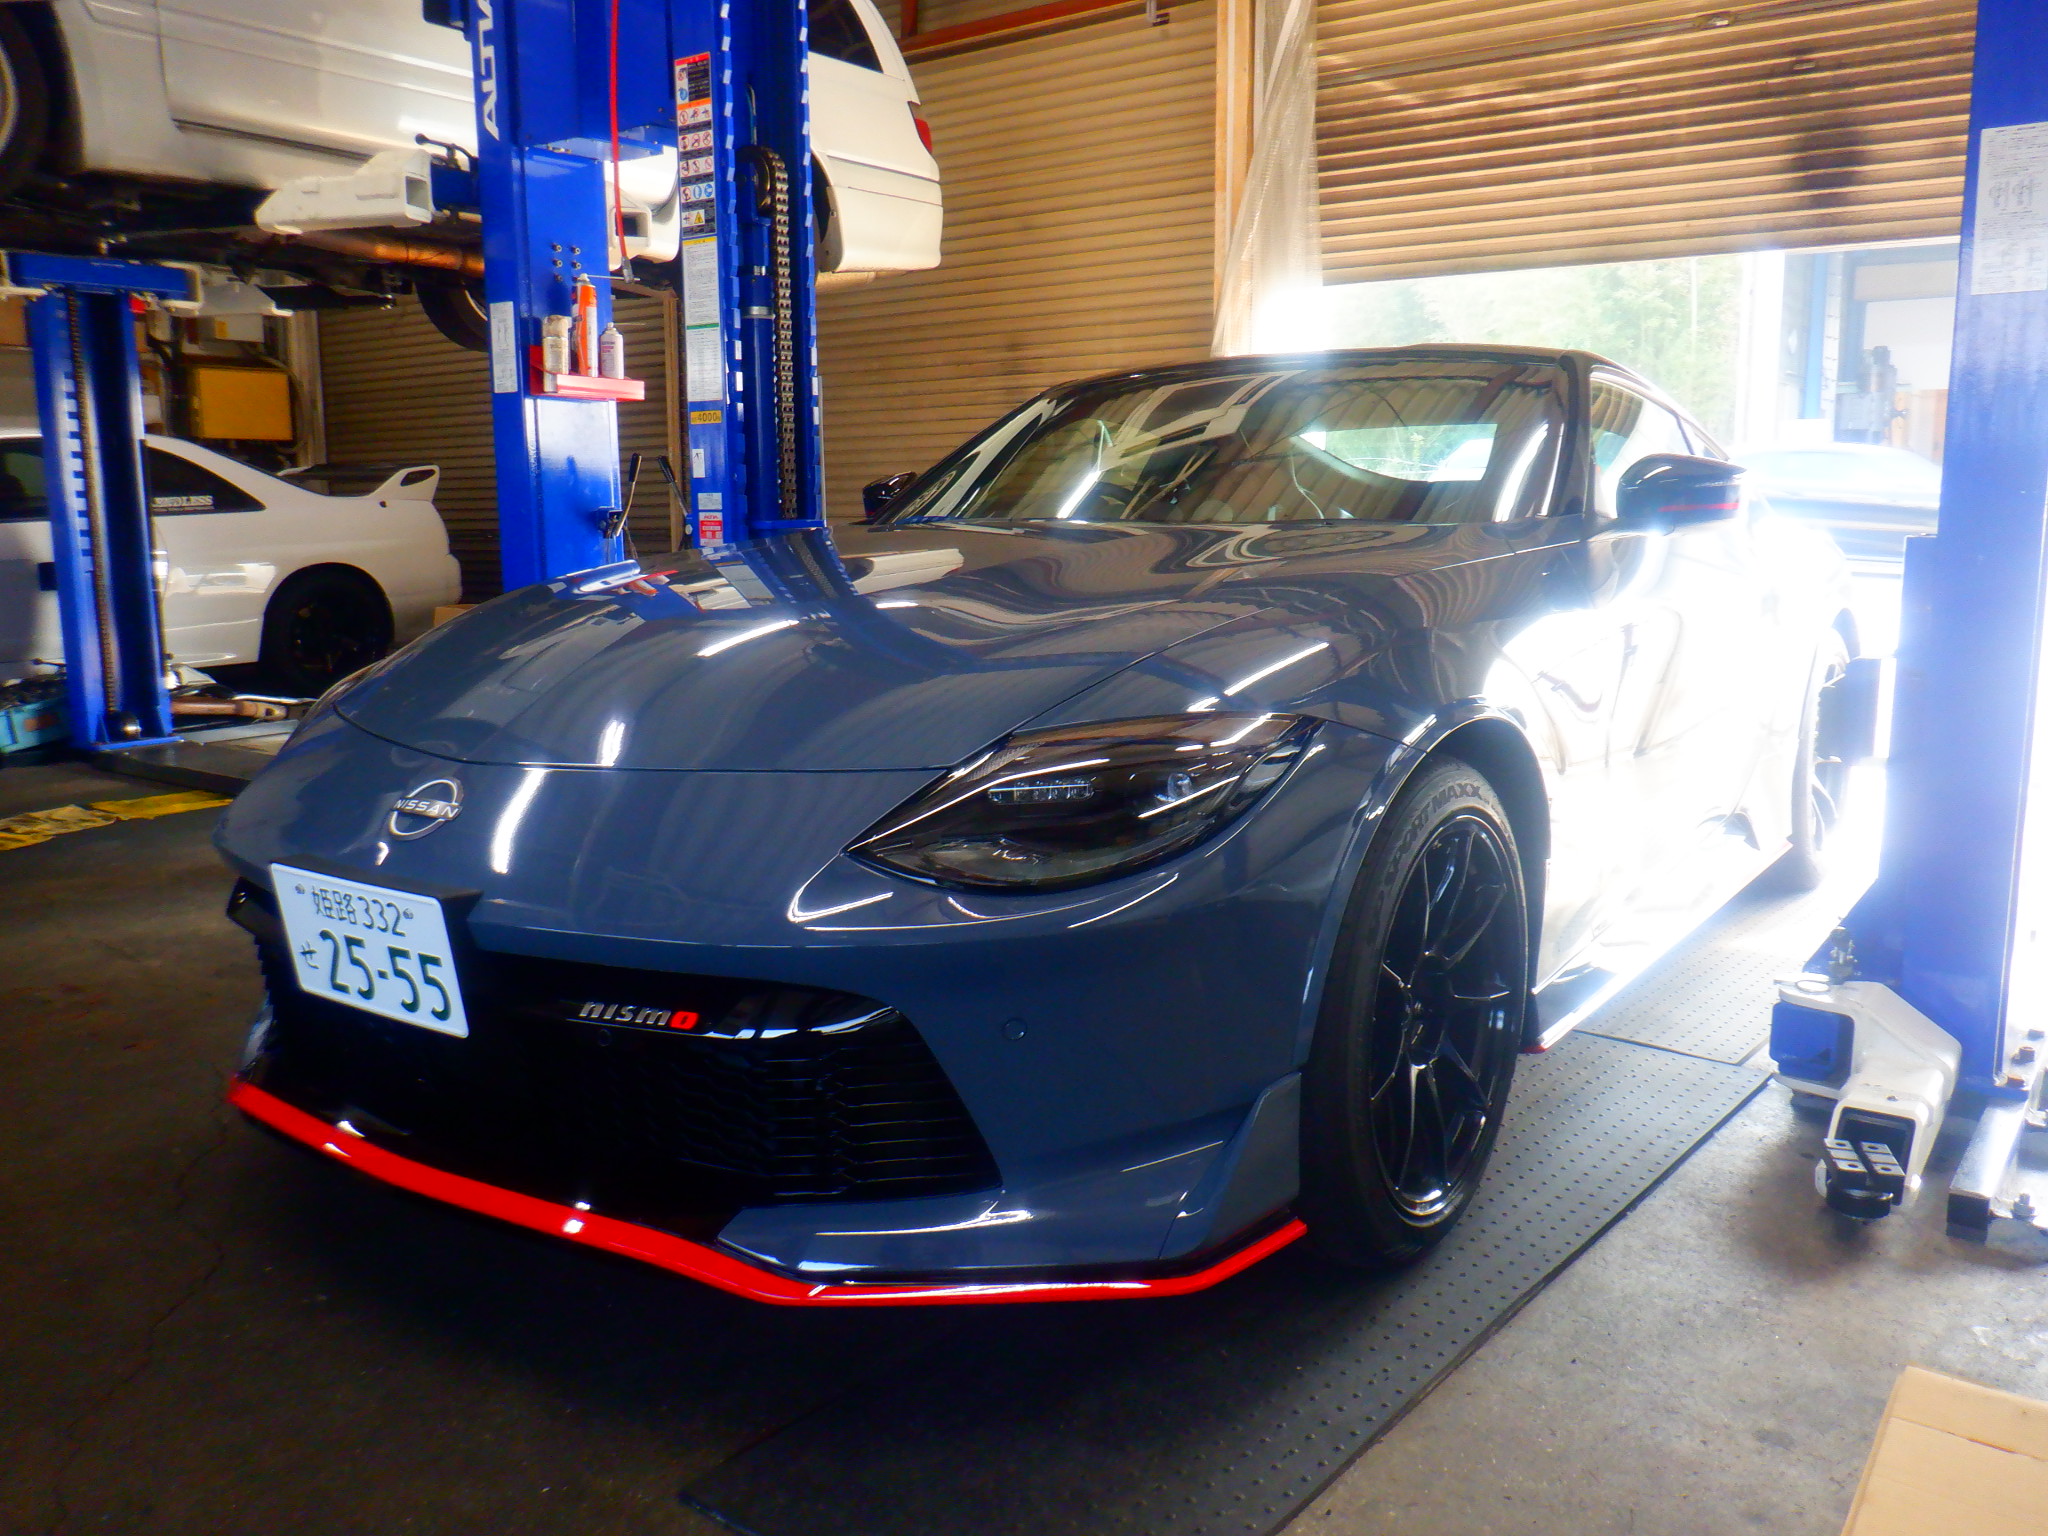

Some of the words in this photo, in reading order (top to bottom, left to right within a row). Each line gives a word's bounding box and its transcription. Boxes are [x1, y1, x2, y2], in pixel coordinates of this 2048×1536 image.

[393, 799, 459, 819] NISSAN
[1431, 782, 1482, 814] MAXX
[319, 929, 452, 1022] 25-55
